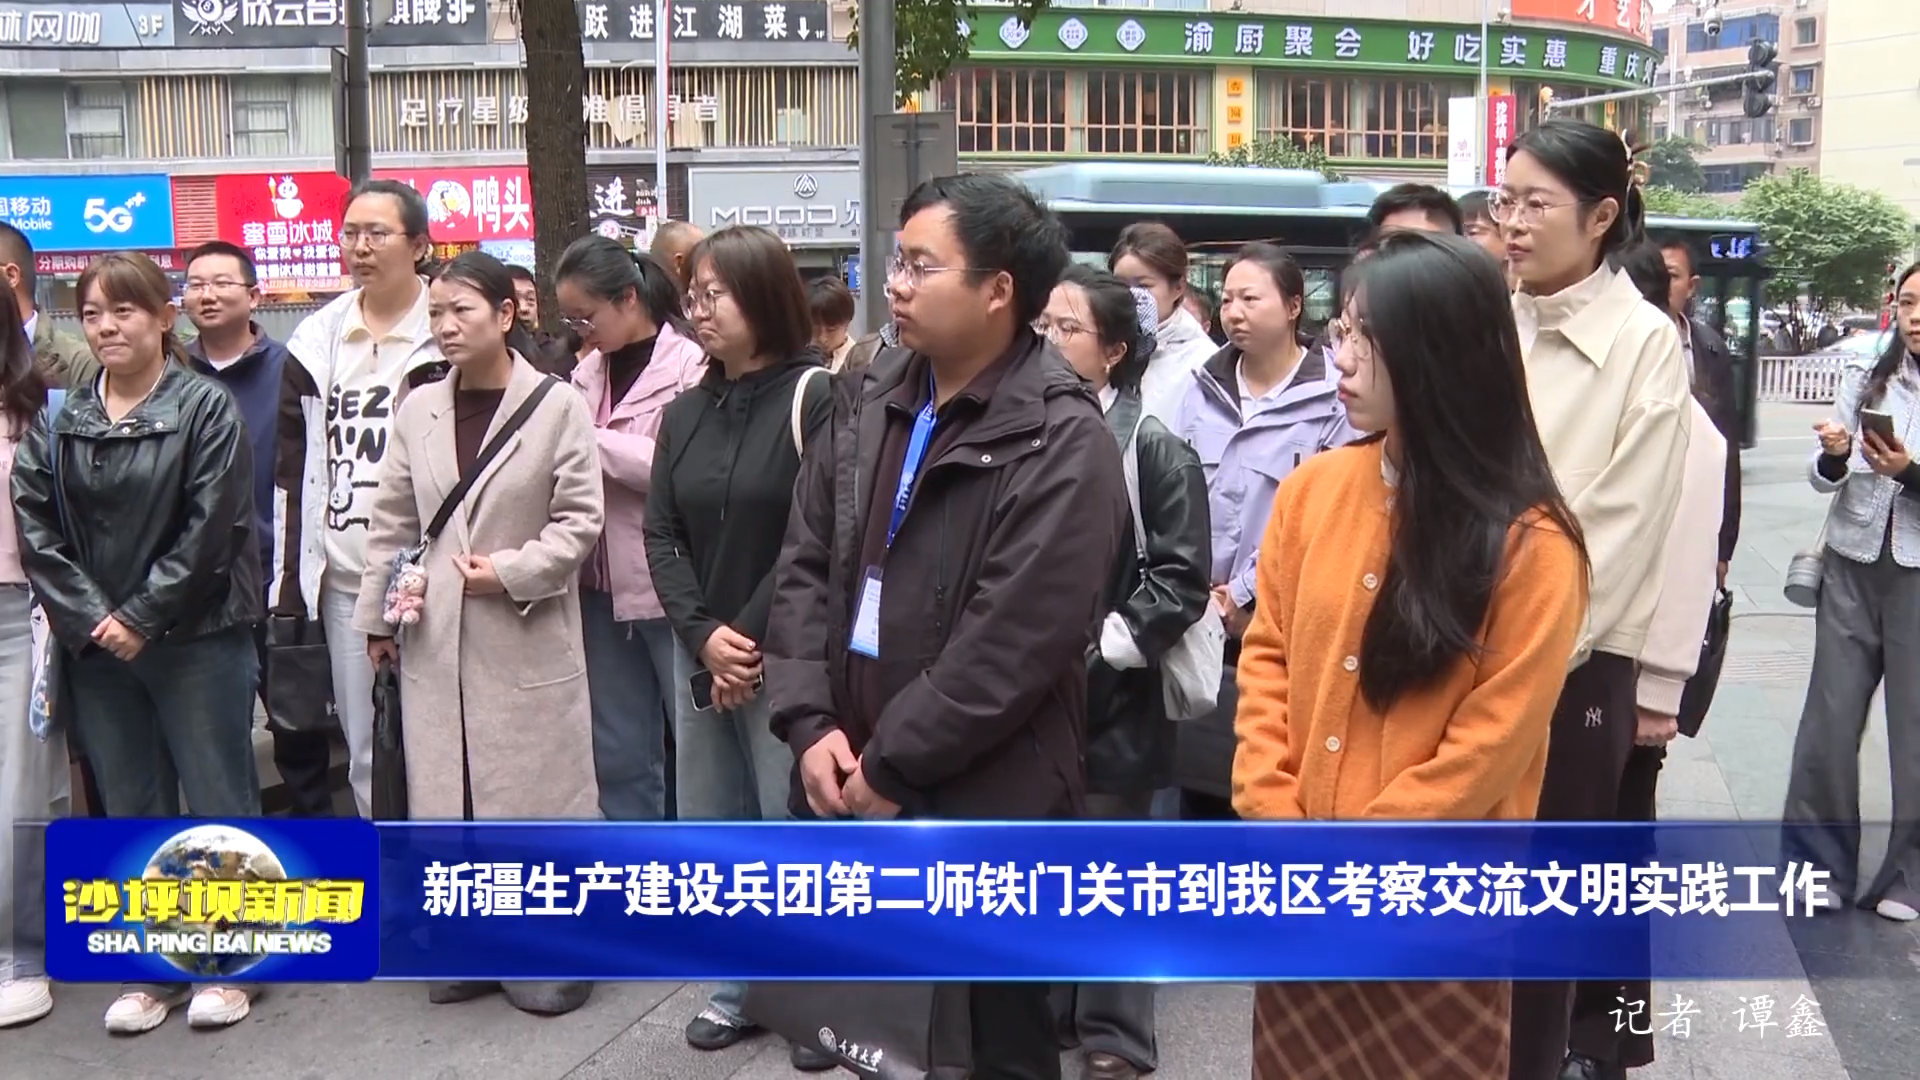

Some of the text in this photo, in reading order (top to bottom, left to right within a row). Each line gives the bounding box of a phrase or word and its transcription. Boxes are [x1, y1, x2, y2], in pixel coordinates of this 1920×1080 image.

[138, 14, 163, 36] 3F
[584, 4, 789, 39] 跃进江湖菜
[1184, 22, 1362, 58] 渝厨聚会
[1407, 31, 1567, 69] 好吃实惠
[472, 175, 530, 233] 鸭头
[711, 205, 837, 227] MOOD
[10, 217, 52, 231] Mobile
[243, 219, 334, 246] 蜜雪冰城
